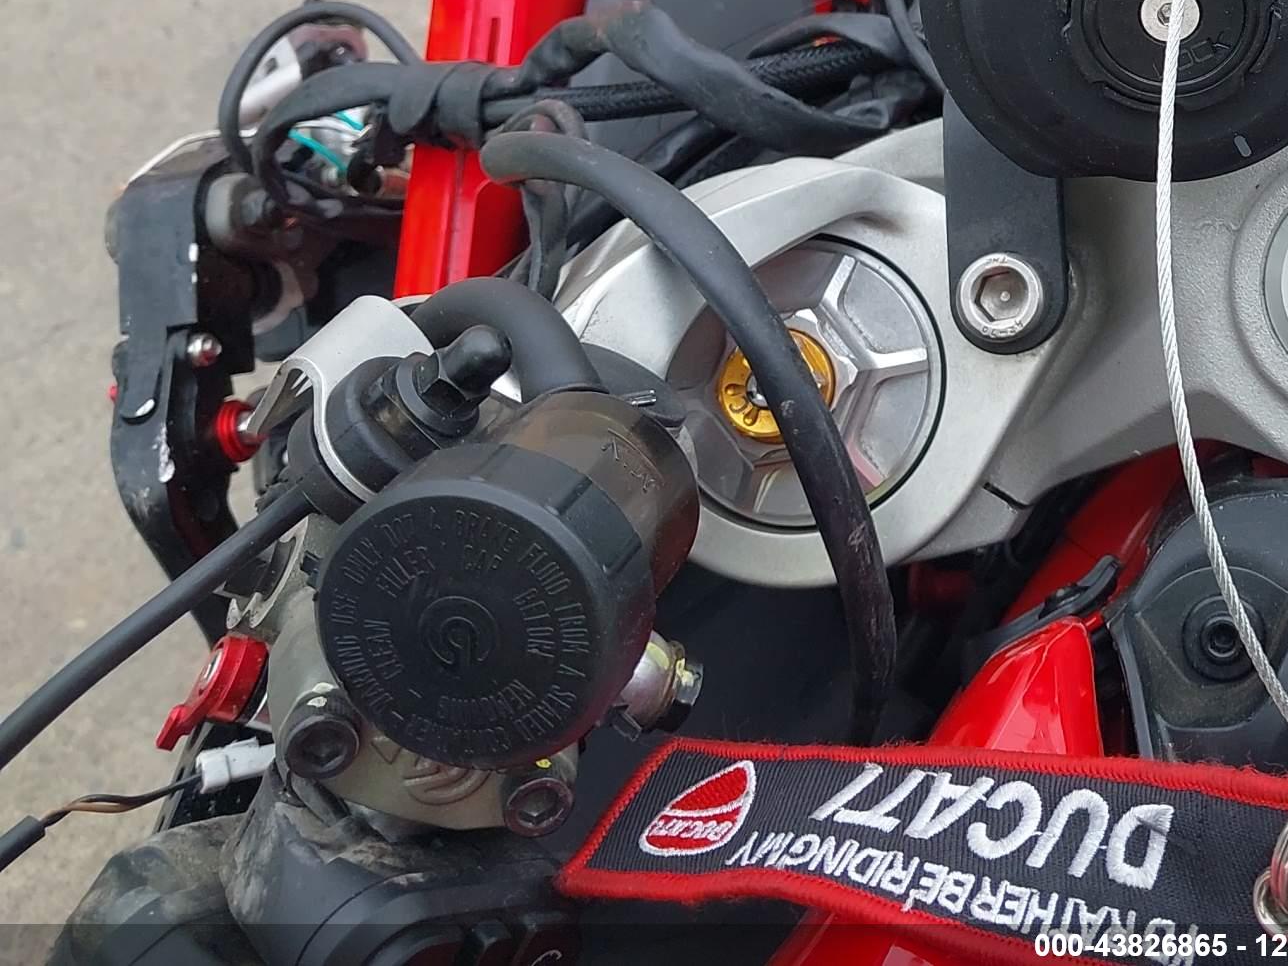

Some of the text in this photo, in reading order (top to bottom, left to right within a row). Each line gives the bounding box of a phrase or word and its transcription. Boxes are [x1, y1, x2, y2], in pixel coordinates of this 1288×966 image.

[373, 512, 414, 549] DOT
[454, 508, 521, 555] BRAKE
[339, 536, 384, 587] ONLY
[375, 544, 438, 600] FILLER
[516, 542, 572, 596] FLUID
[362, 618, 405, 682] CLEAN
[553, 601, 591, 658] FROM
[511, 683, 578, 743] SEALED
[648, 818, 733, 842] DUCATI
[725, 830, 794, 870] MY
[809, 762, 1175, 891] DUCATI
[783, 832, 920, 893] RIDING
